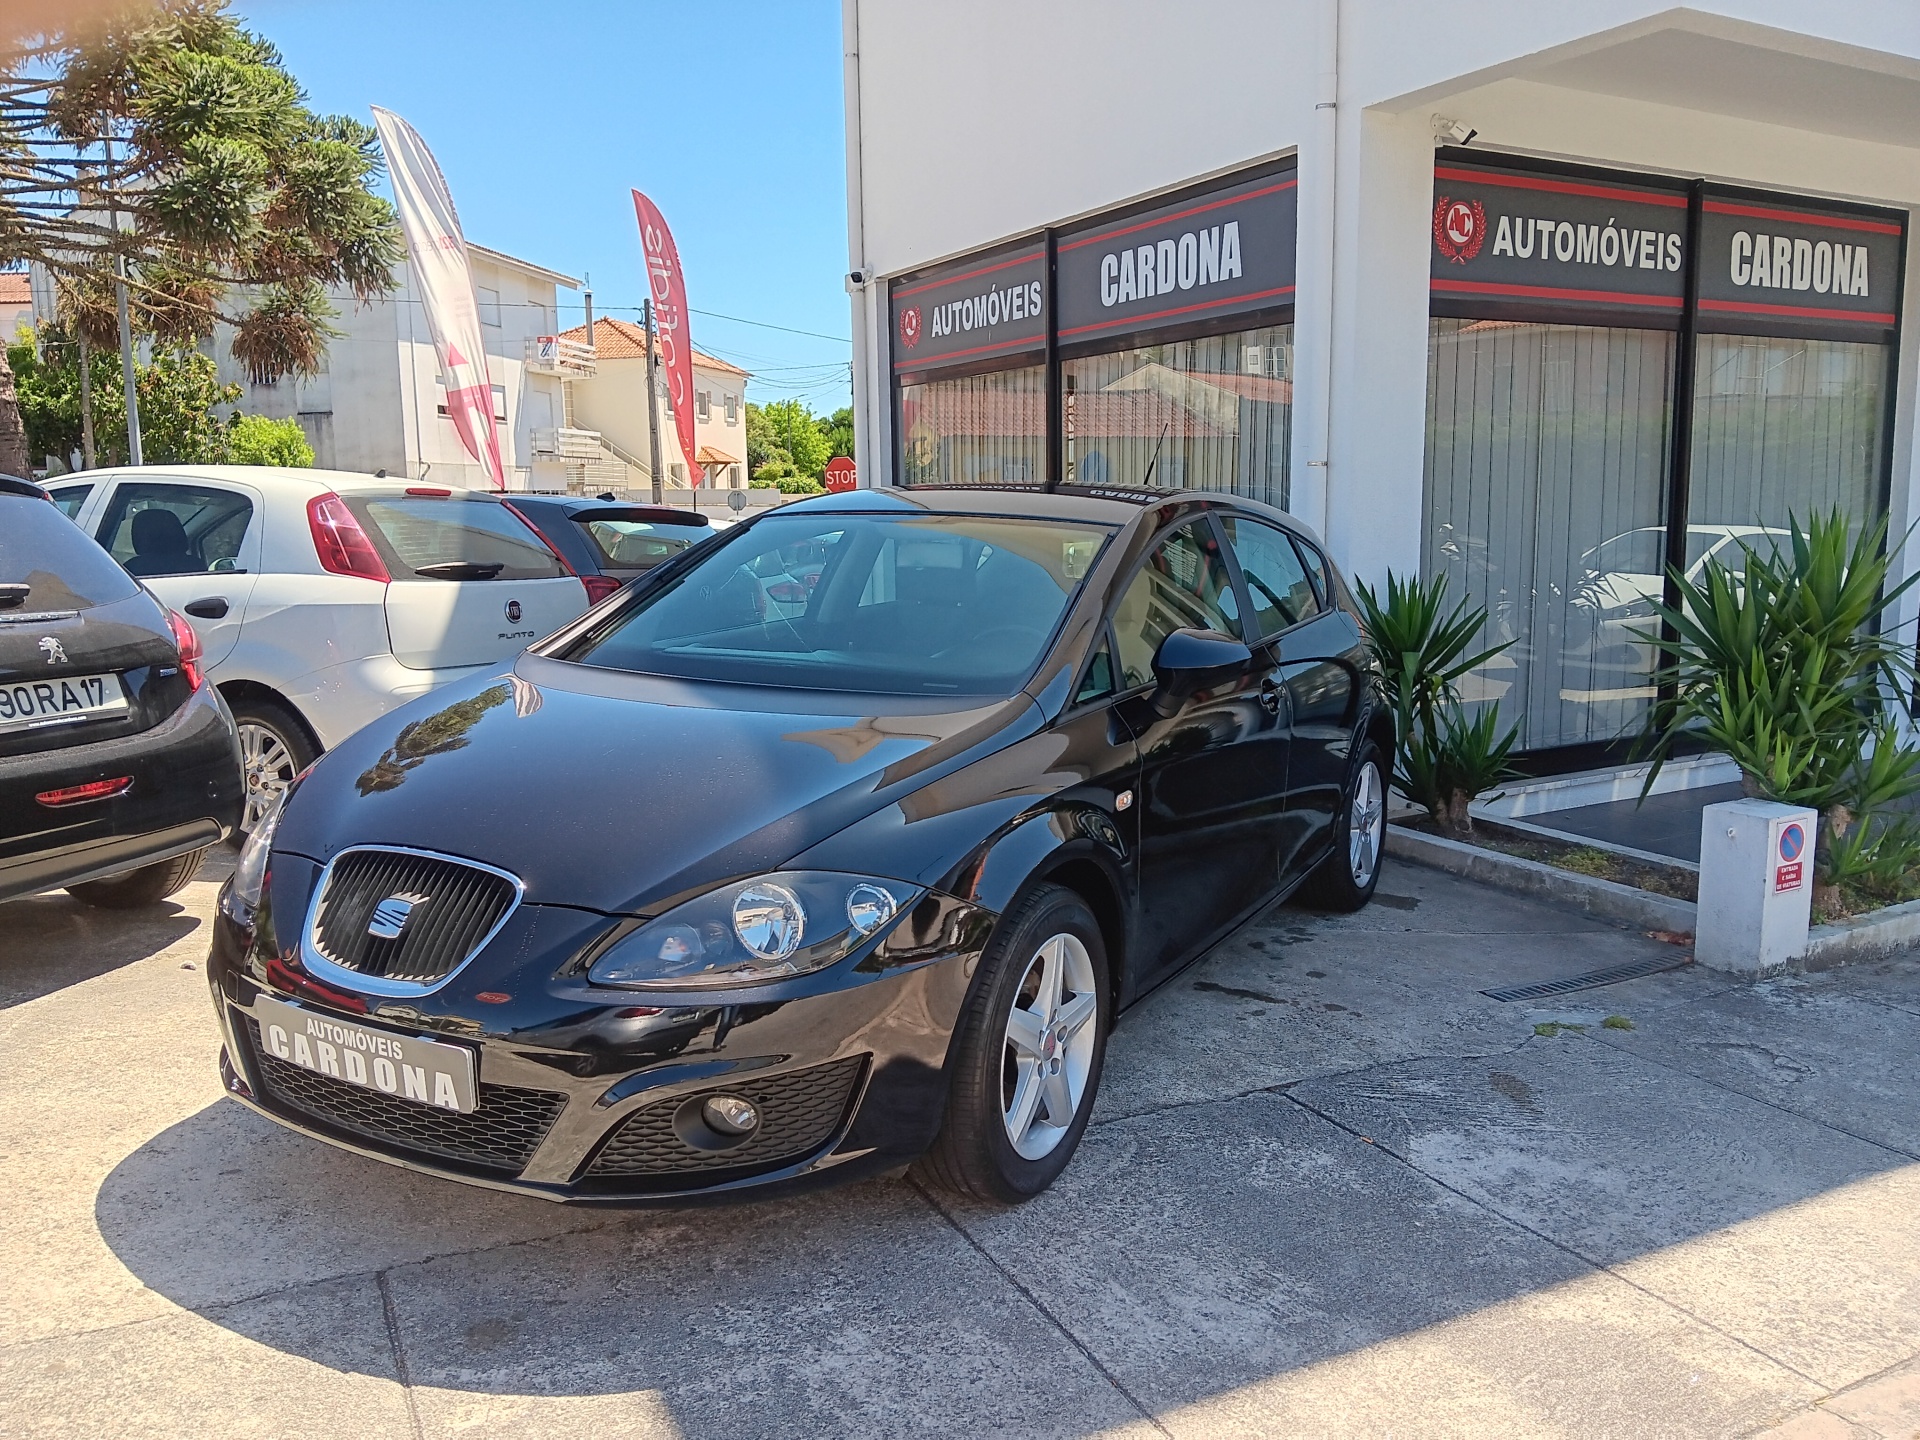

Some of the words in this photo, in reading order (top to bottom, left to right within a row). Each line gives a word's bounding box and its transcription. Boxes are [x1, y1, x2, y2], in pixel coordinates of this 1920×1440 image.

[931, 280, 1042, 338] AUTOMÓVEIS
[1101, 220, 1243, 307] CARDONA
[1492, 215, 1682, 272] AUTOMÓVEIS
[1730, 230, 1869, 297] CARDONA
[826, 470, 857, 485] STOP
[498, 631, 534, 639] PUNTO
[269, 1024, 460, 1110] CARDONA
[306, 1017, 404, 1060] AUTOMÓVEIS
